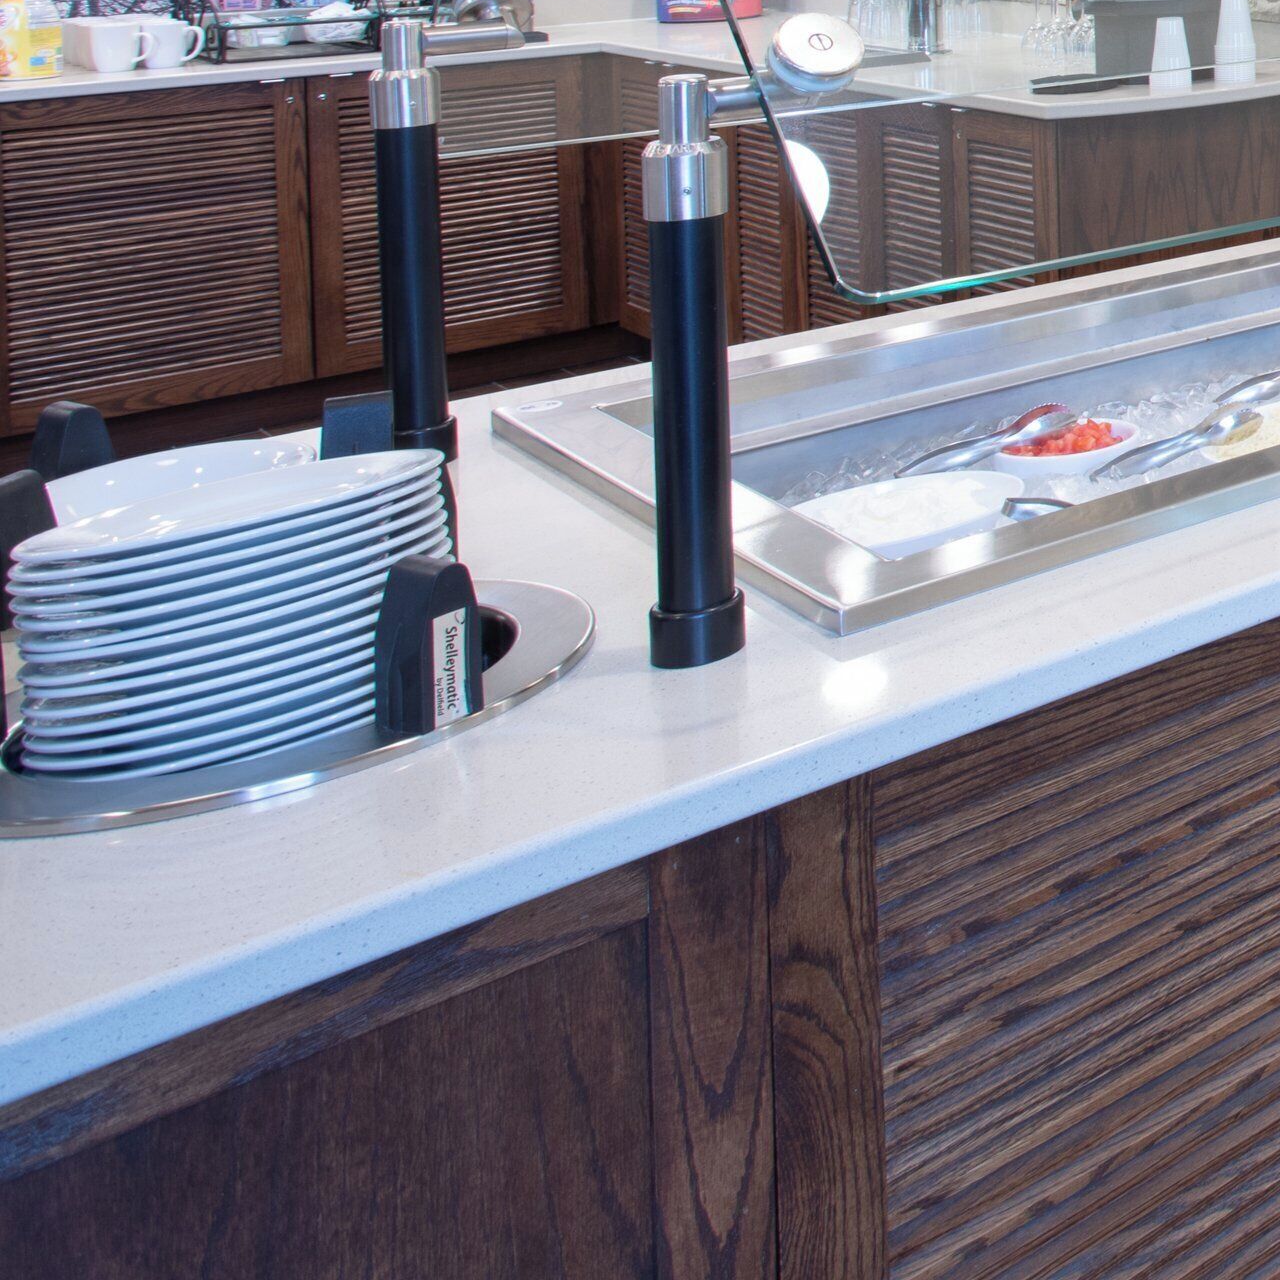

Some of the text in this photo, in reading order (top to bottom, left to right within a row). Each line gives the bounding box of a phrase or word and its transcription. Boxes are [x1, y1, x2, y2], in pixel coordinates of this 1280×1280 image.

[435, 677, 445, 716] by Delfield
[443, 626, 459, 710] Shelleymatic
